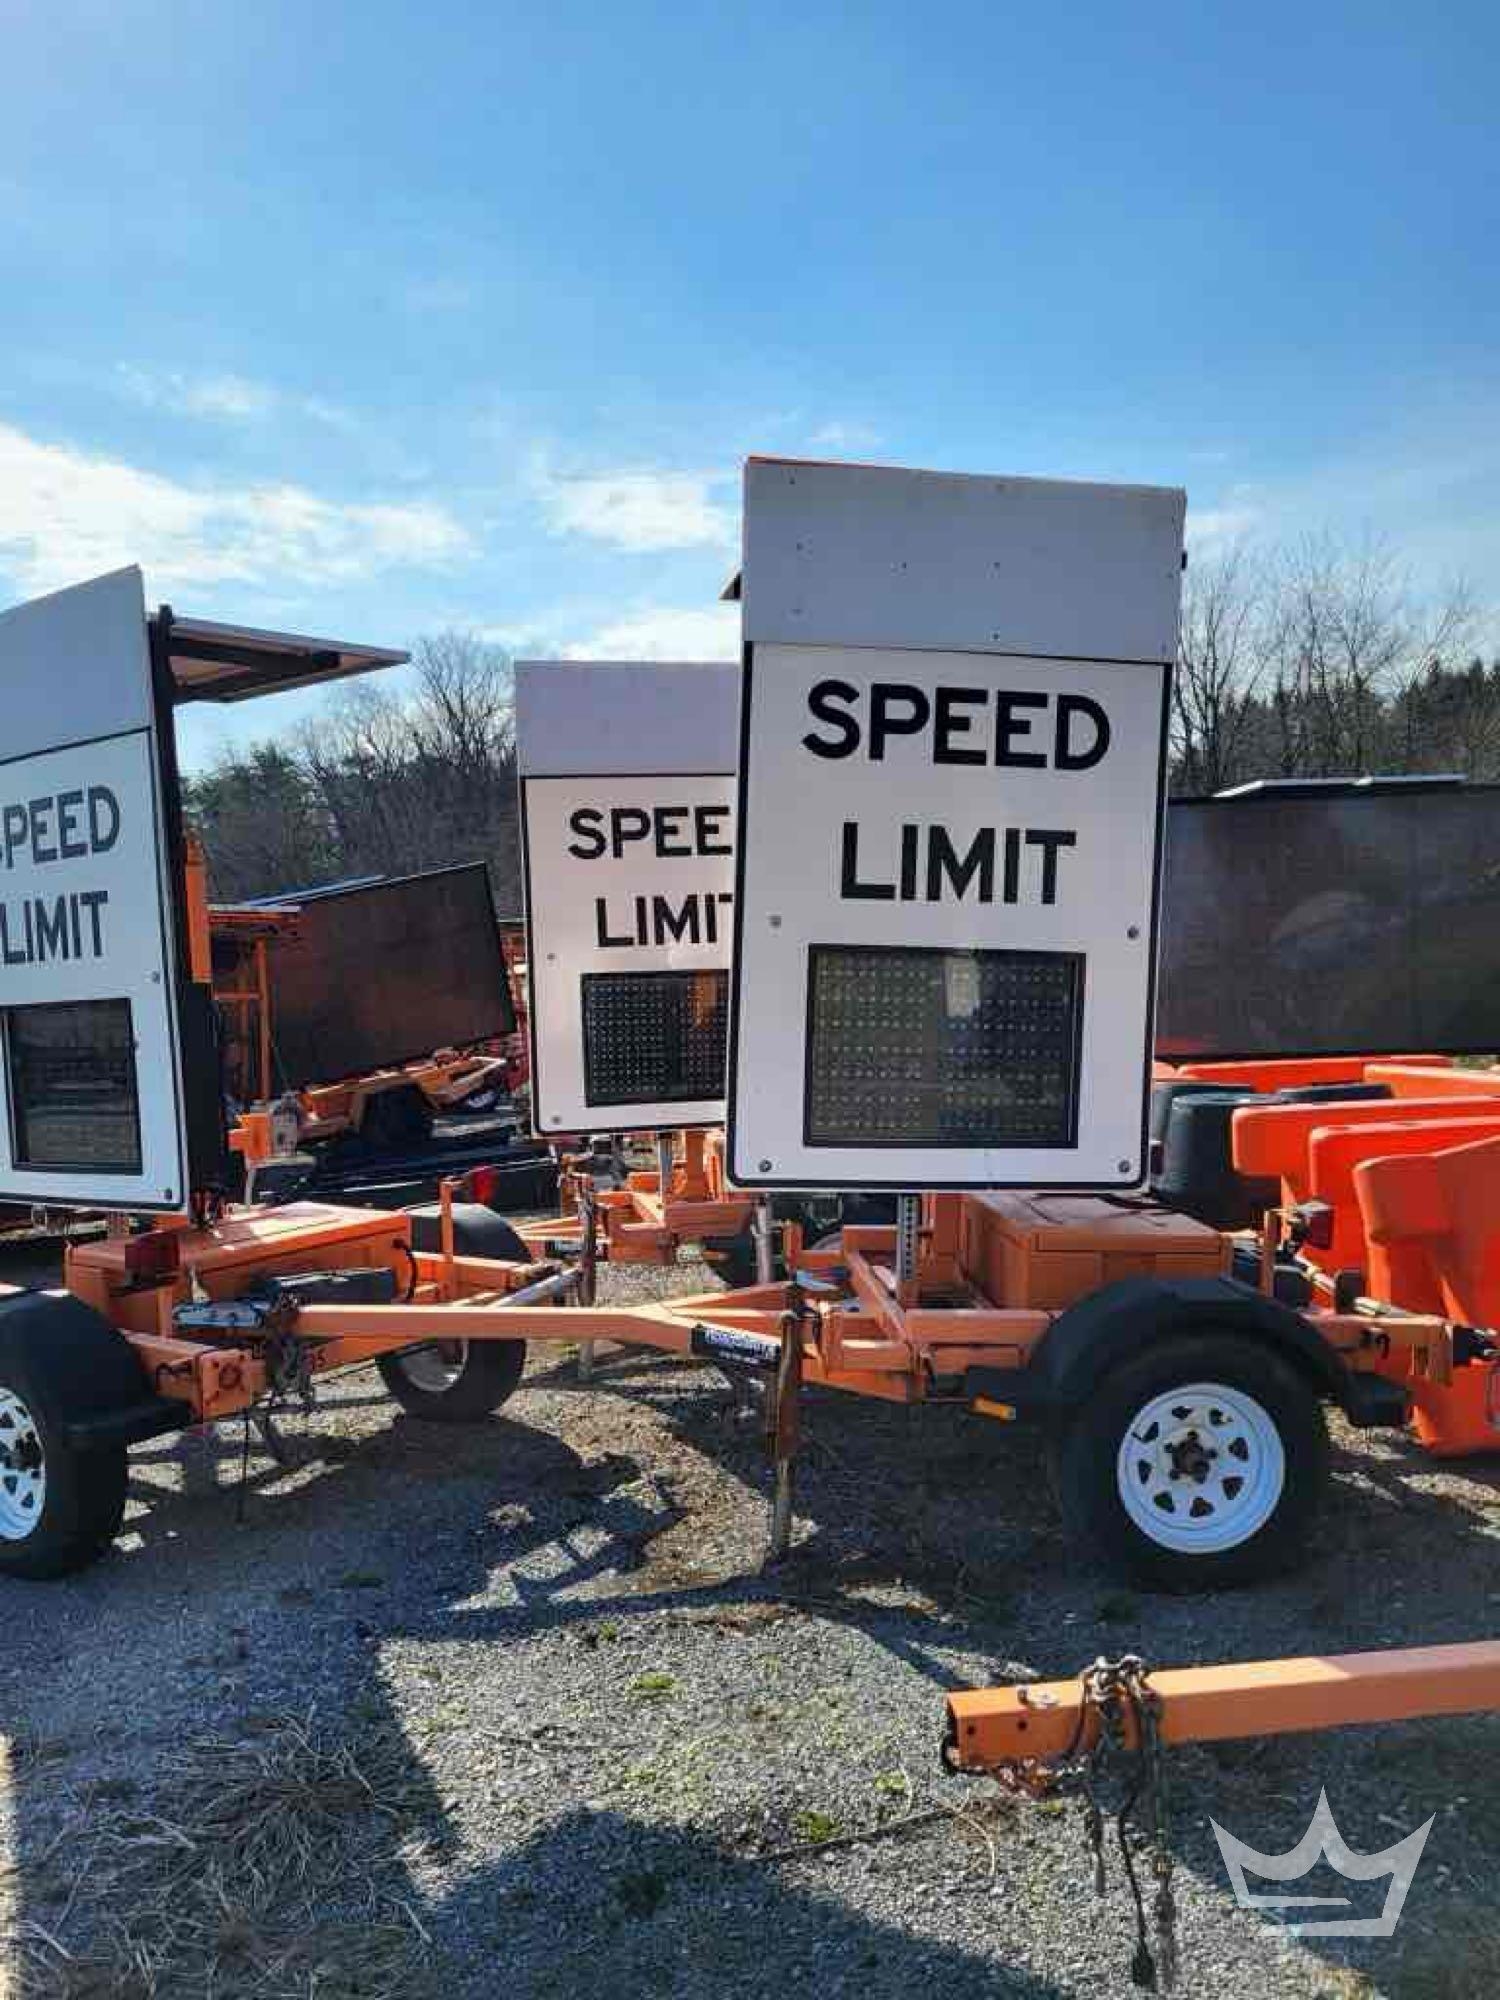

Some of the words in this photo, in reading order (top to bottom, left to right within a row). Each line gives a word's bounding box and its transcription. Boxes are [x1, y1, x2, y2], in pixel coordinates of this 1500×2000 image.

[802, 679, 1111, 770] SPEED
[0, 785, 120, 870] PEED
[568, 806, 733, 860] SPEE
[841, 821, 1077, 905] LIMIT
[0, 890, 108, 964] LIMIT
